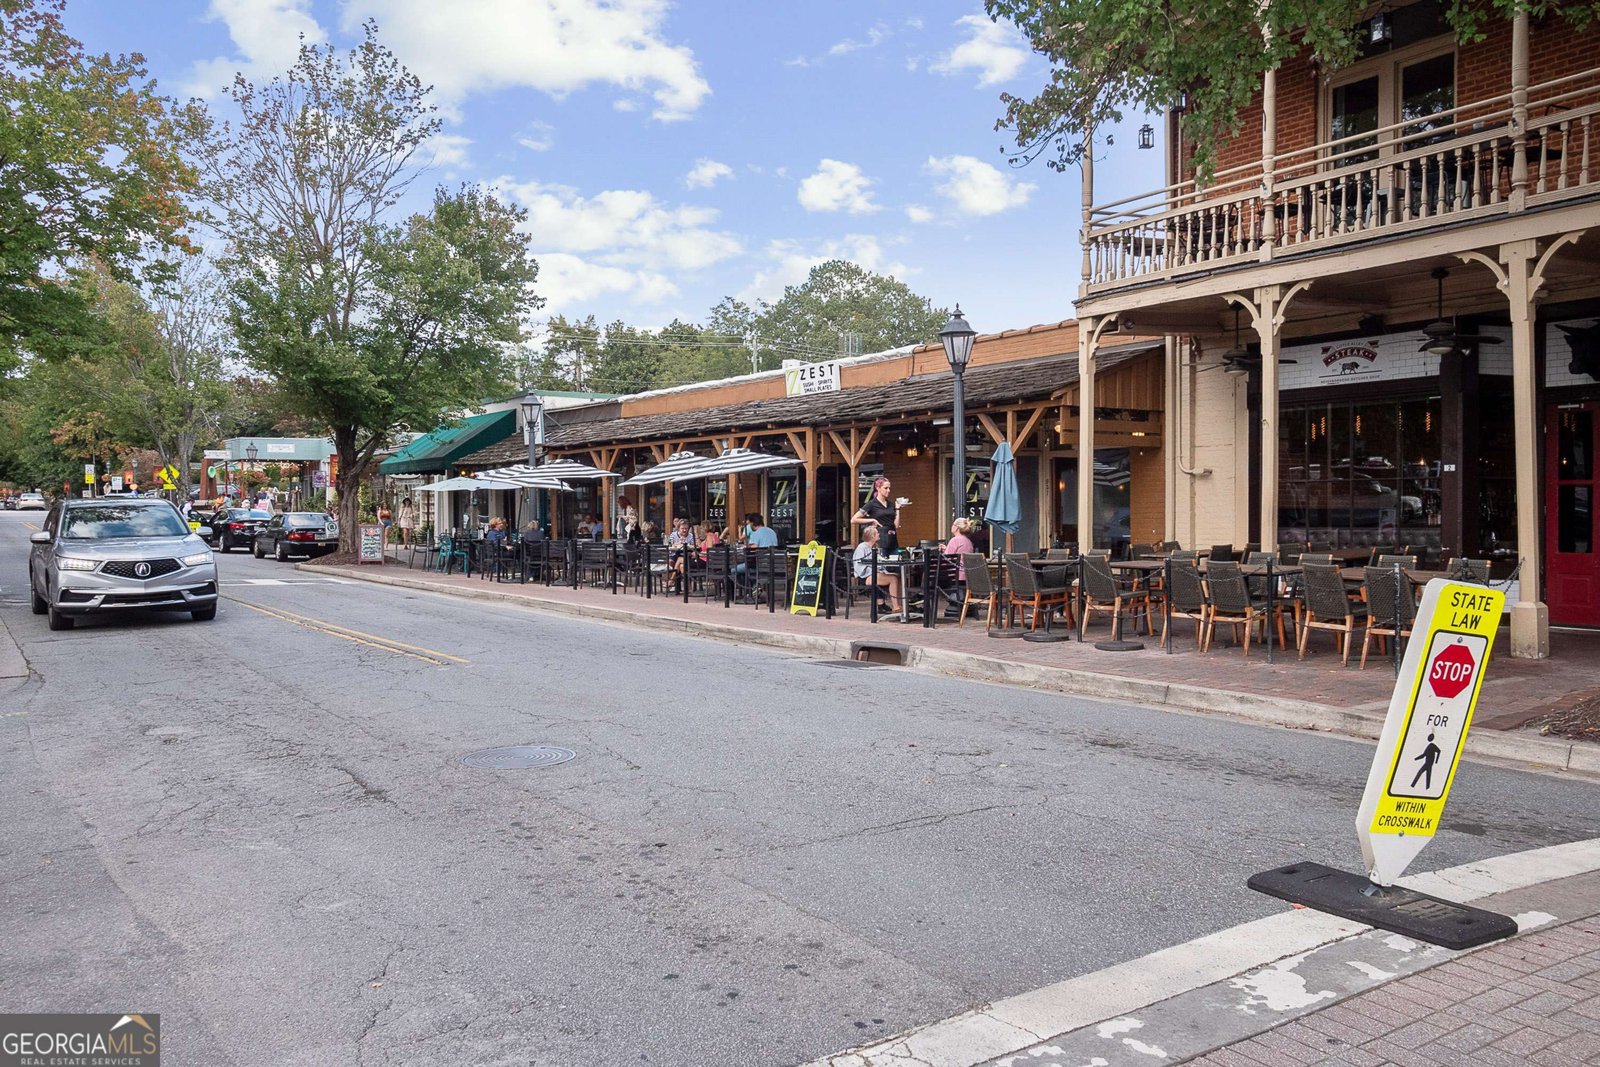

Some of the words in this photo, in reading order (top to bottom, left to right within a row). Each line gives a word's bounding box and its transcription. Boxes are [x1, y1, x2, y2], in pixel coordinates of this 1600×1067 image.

[1335, 349, 1364, 359] STEAK
[800, 364, 833, 380] ZEST
[709, 508, 727, 517] ZES
[771, 508, 793, 517] ZEST
[1451, 591, 1494, 612] STATE
[1451, 612, 1481, 630] LAW
[1432, 661, 1471, 682] STOP
[1426, 714, 1448, 727] FOR
[1395, 801, 1426, 813] WITHIN
[1378, 815, 1432, 829] CROSSWALK
